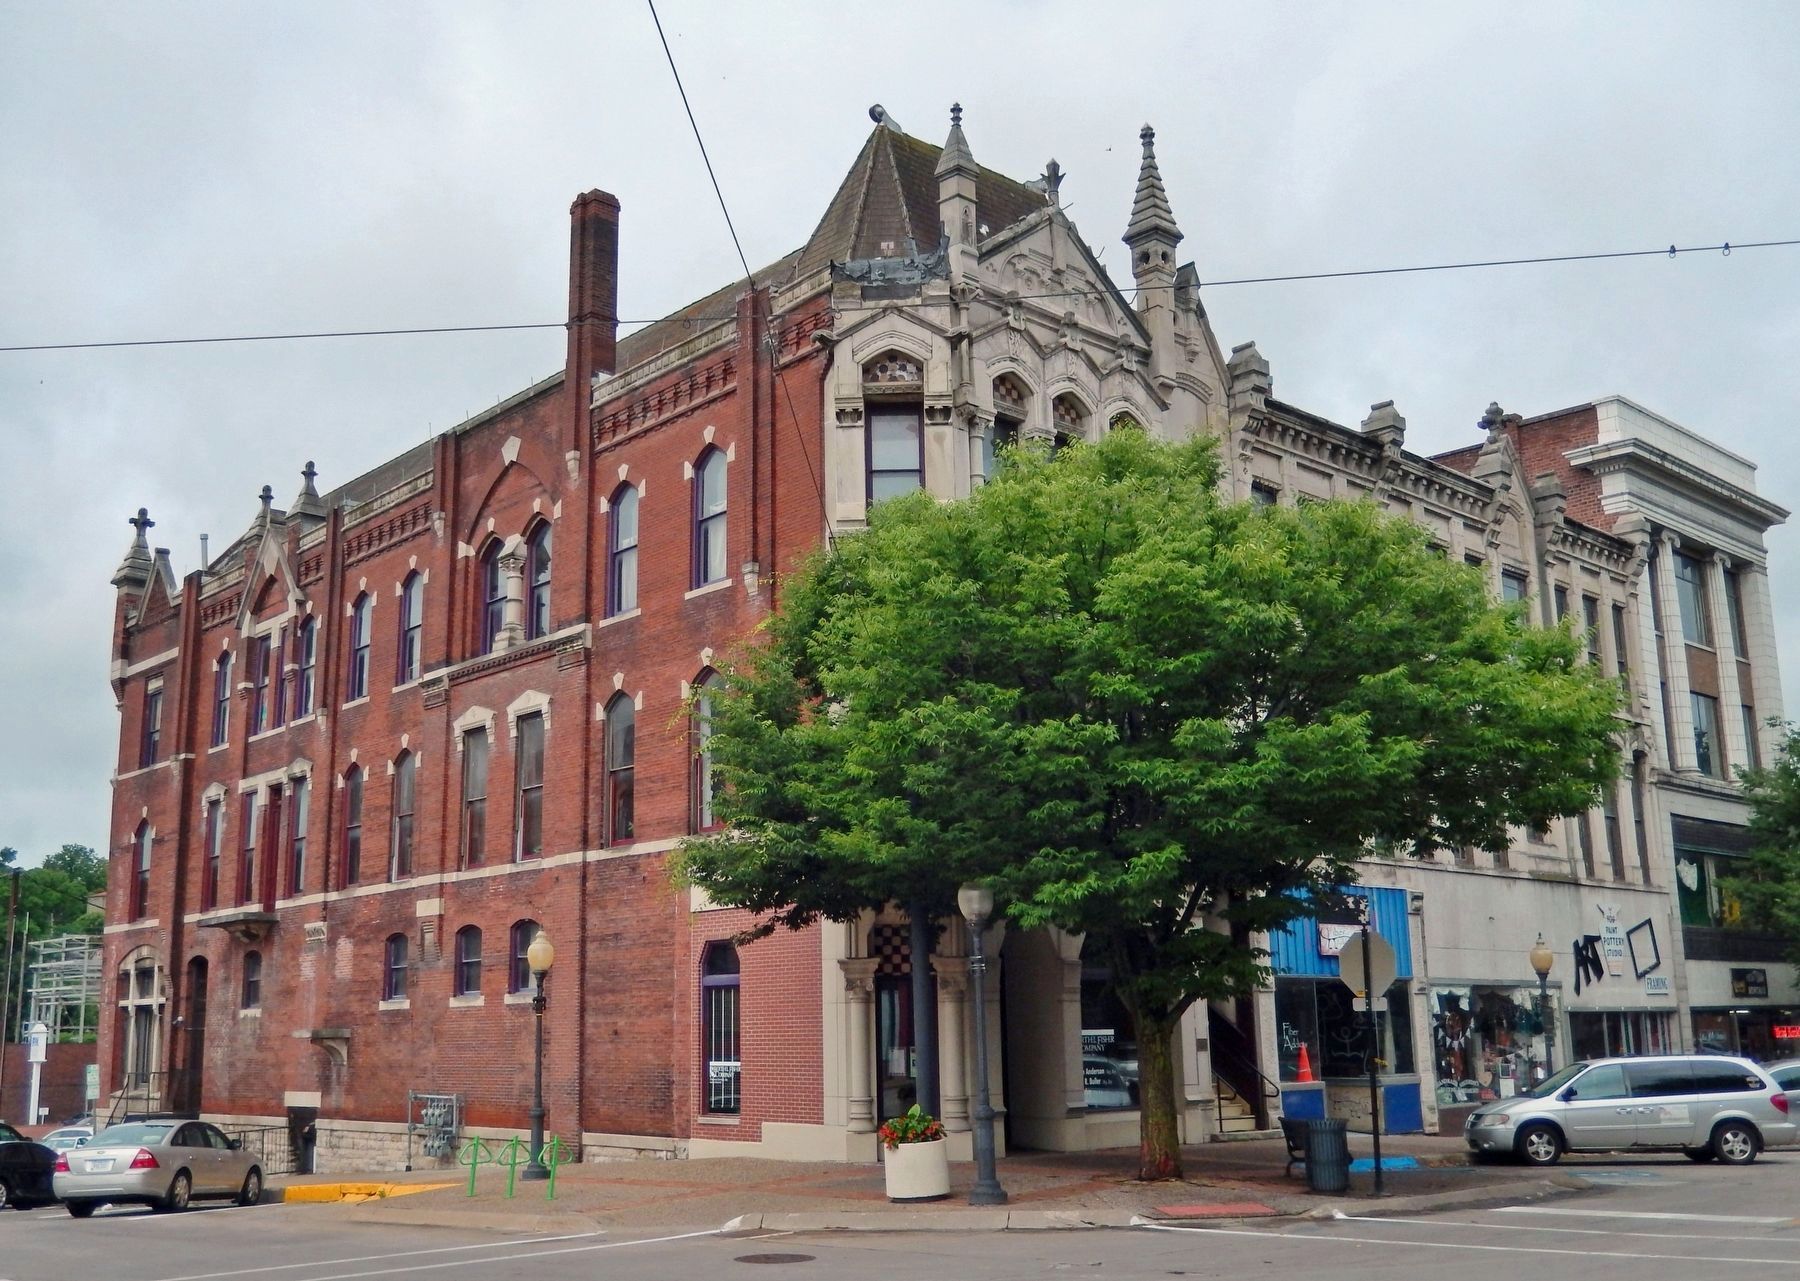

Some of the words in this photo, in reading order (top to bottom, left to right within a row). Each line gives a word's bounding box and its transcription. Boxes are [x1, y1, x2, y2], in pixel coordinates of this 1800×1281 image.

[1603, 937, 1624, 946] POTTERY
[1573, 934, 1604, 997] ART
[1647, 977, 1668, 989] FRAMING
[1098, 1036, 1115, 1044] FISHER
